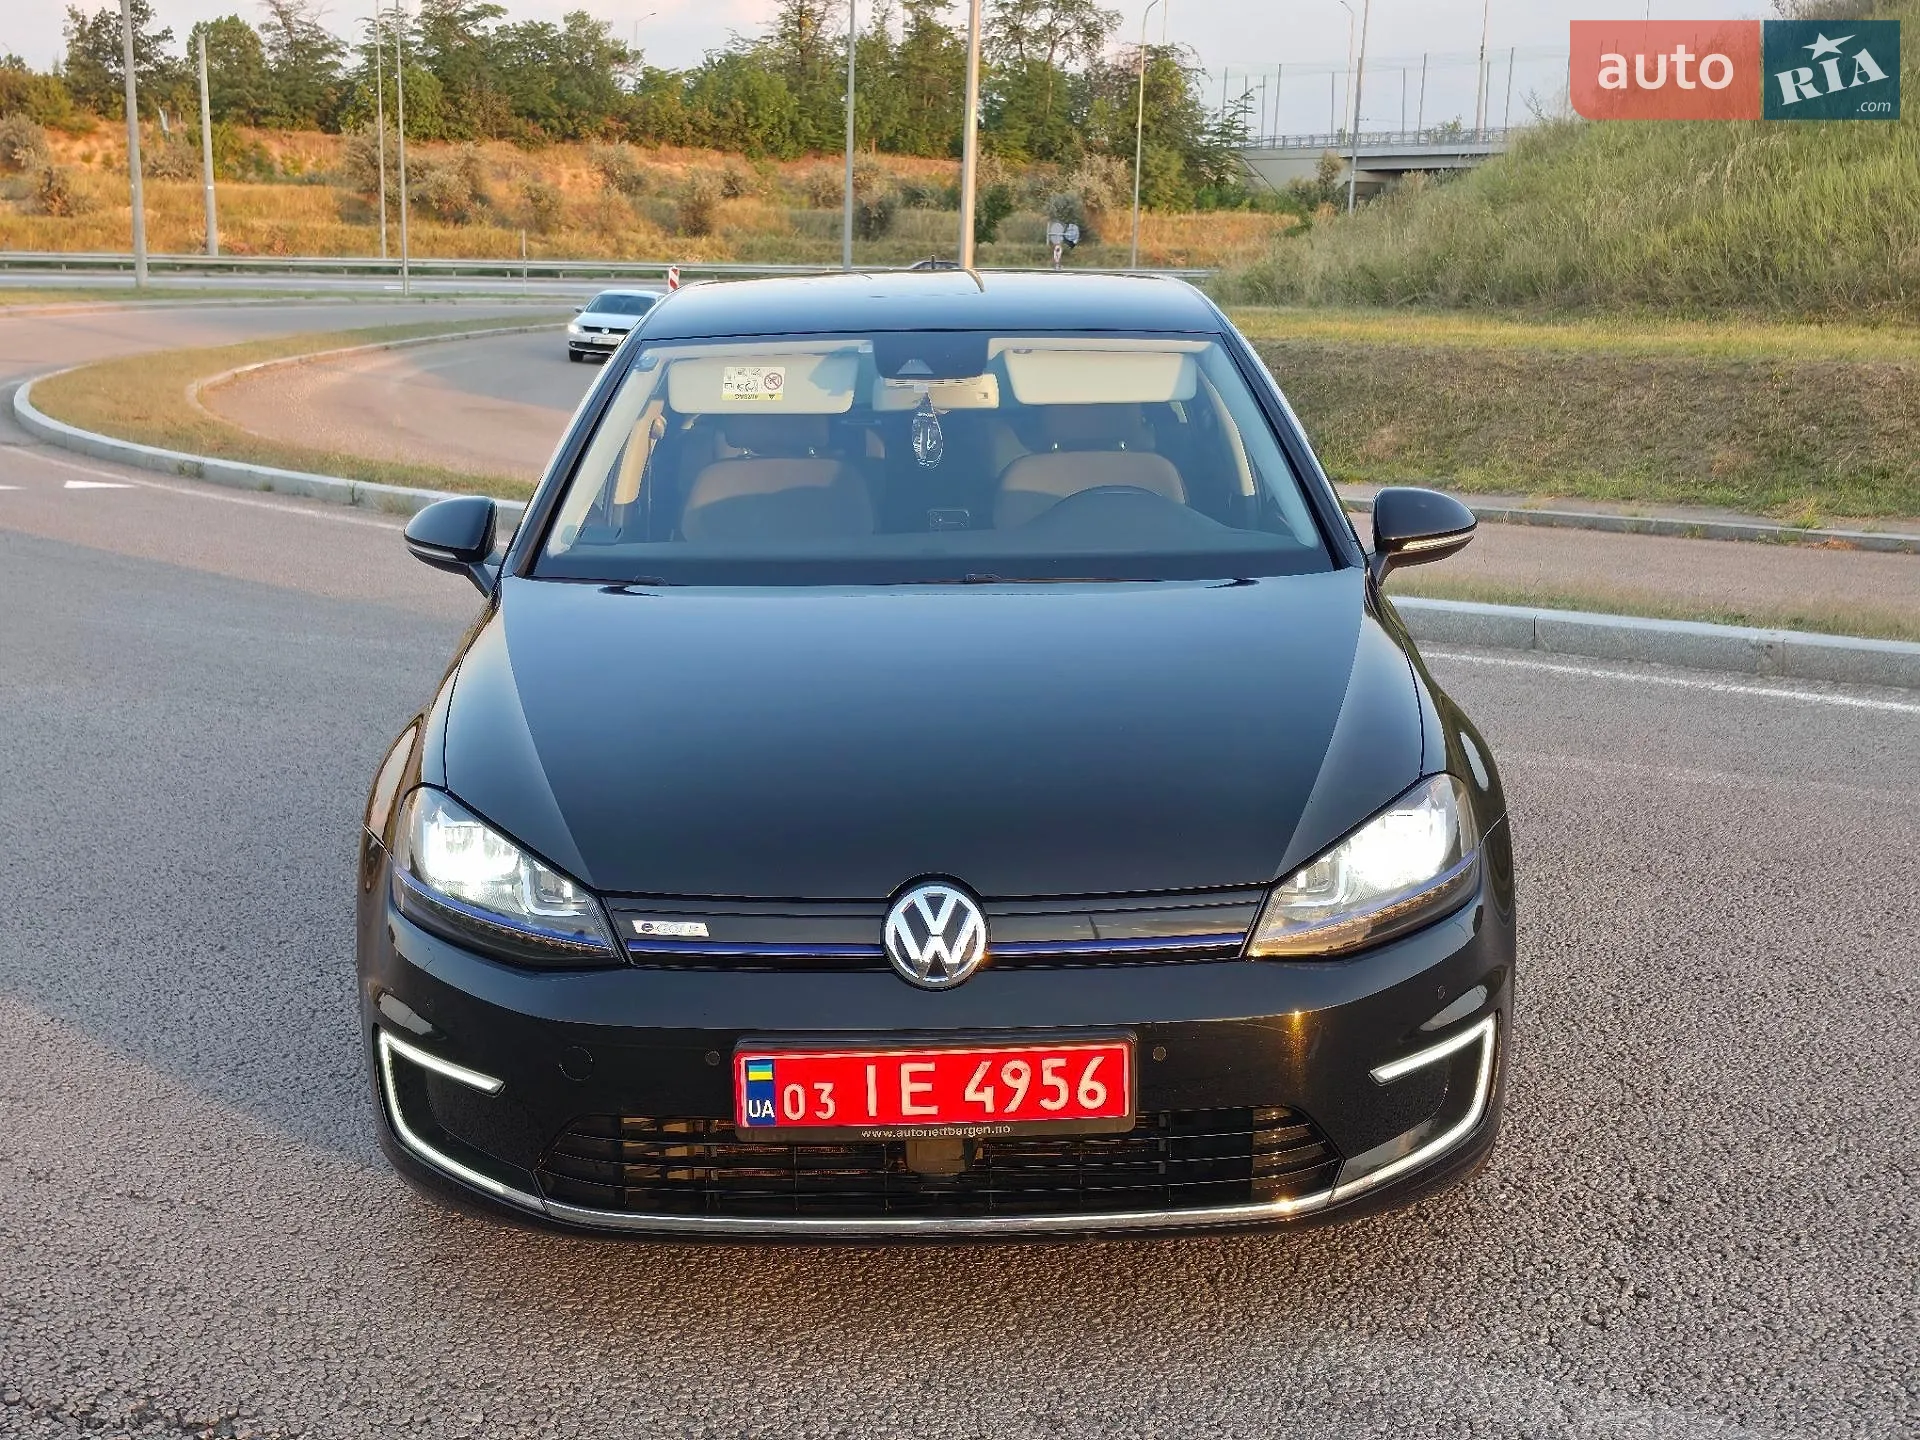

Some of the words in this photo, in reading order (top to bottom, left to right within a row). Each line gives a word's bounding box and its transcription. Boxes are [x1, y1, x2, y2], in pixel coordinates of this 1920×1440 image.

[748, 1100, 774, 1118] UA
[783, 1082, 836, 1120] 03
[866, 1063, 938, 1117] IE
[964, 1056, 1107, 1113] 4956
